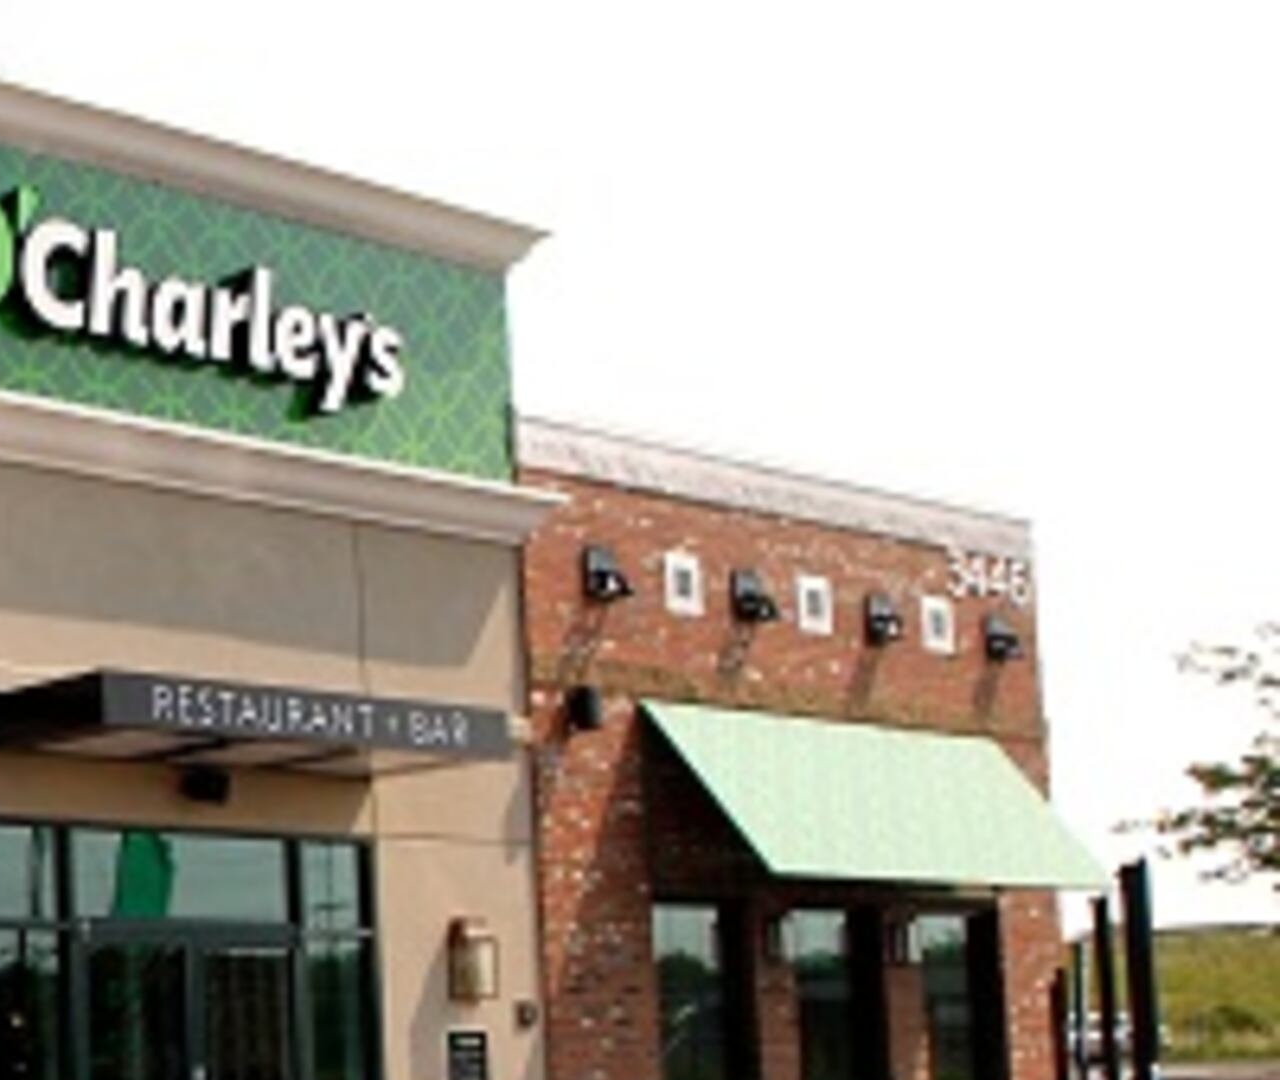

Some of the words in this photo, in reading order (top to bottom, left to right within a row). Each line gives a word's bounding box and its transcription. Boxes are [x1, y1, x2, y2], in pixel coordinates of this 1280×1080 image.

[946, 548, 1030, 608] 3446
[151, 684, 374, 738] RESTAURANT
[407, 709, 469, 746] BAR
